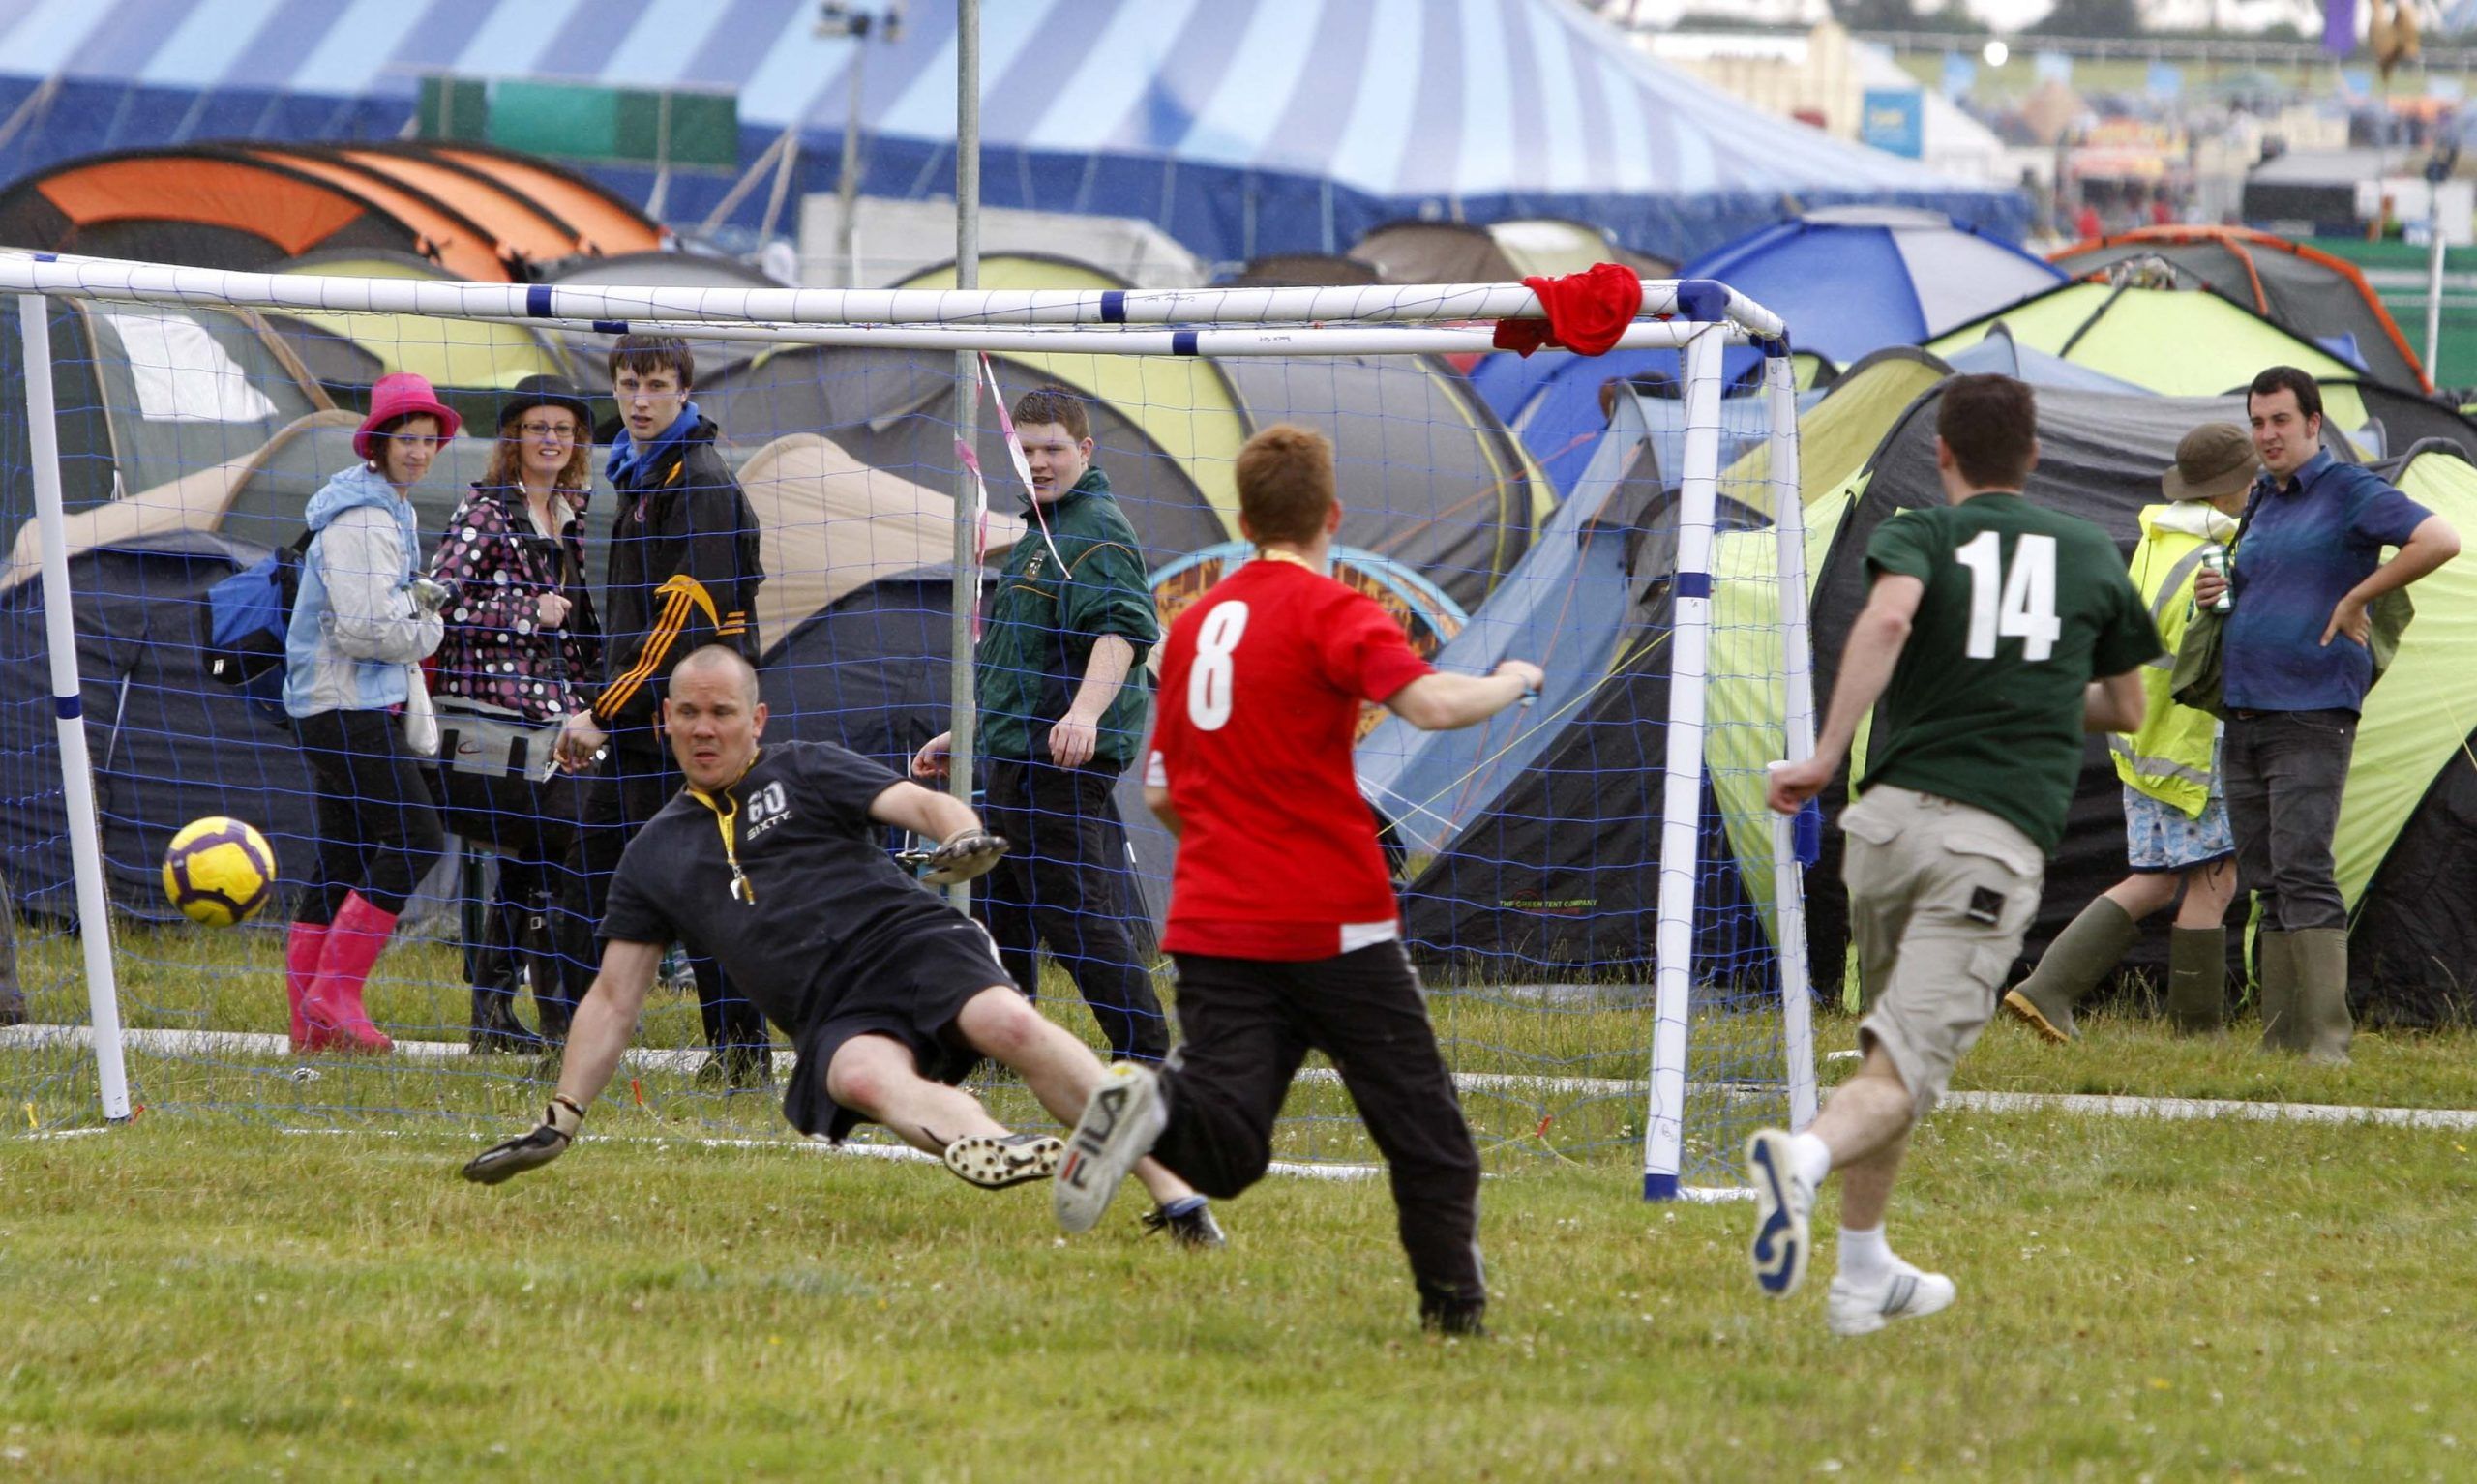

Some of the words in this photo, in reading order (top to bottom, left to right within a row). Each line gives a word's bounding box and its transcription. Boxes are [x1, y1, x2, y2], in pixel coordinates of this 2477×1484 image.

[1955, 530, 2061, 661] 14
[1187, 600, 1249, 731] 8
[747, 810, 791, 841] SIXTY
[748, 780, 786, 823] 60
[1564, 899, 1597, 907] COMPANY
[1060, 1088, 1128, 1191] FILA
